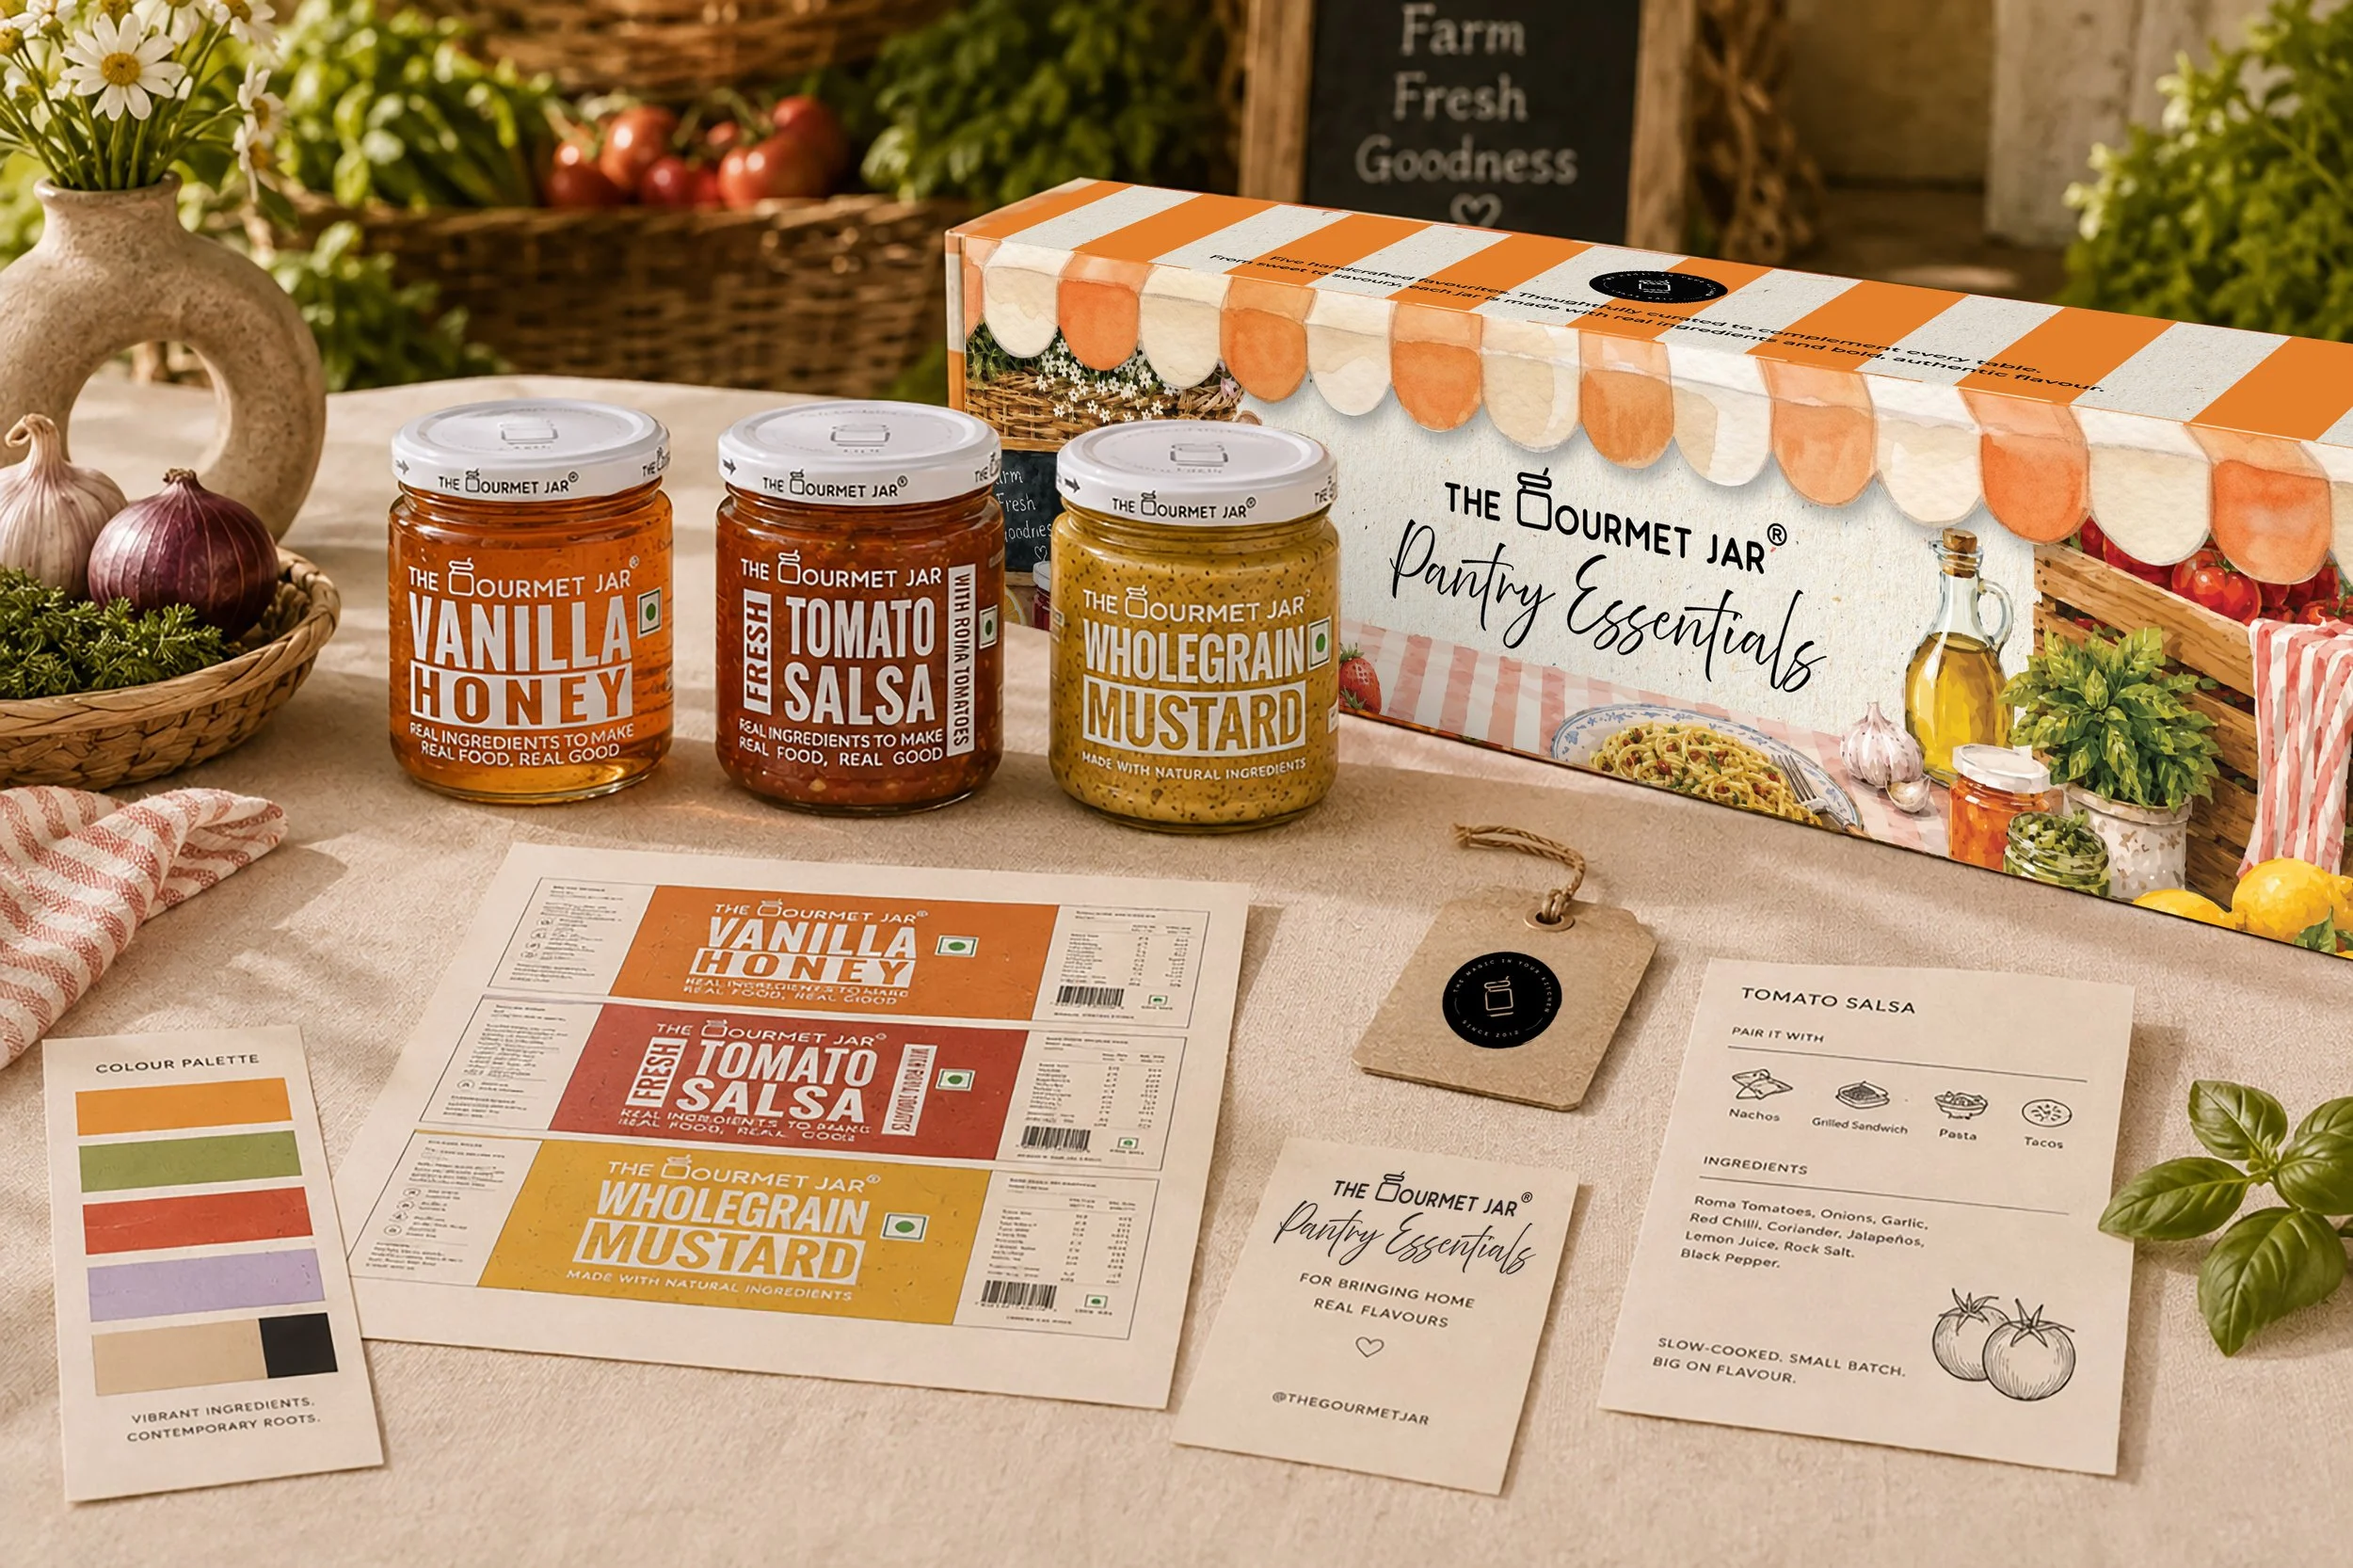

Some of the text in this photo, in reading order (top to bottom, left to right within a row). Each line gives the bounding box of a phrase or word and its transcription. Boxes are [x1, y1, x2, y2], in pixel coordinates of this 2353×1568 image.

[1401, 3, 1526, 56] Farm
[1393, 70, 1528, 121] Fresh
[1355, 133, 1578, 185] Goodness
[1209, 254, 1253, 264] From
[1257, 262, 1307, 273] sweet
[1409, 285, 1451, 295] each
[1449, 290, 1481, 298] jar
[1504, 298, 1560, 312] made
[1565, 307, 1609, 318] with
[1614, 314, 1653, 325] real
[1657, 320, 1778, 343] ingredients
[1783, 340, 1827, 350] and
[1893, 357, 2009, 377] authentic
[2015, 374, 2105, 392] flavour.
[1270, 255, 1305, 264] Five
[1307, 262, 1416, 280] handcrafted
[1519, 292, 1641, 314] Thoughtfully
[1647, 312, 1727, 327] curated
[1758, 328, 1901, 353] complement
[1906, 348, 1971, 363] every
[1977, 359, 2041, 374] table.
[438, 475, 460, 491] THE
[762, 476, 784, 493] THE
[996, 471, 1023, 485] arm
[996, 492, 1035, 512] Fresh
[1112, 497, 1136, 513] THE
[1444, 481, 1501, 522] THE
[1004, 520, 1051, 542] oodnes
[408, 566, 440, 592] THE
[741, 557, 770, 582] THE
[905, 567, 941, 587] JAR
[954, 573, 970, 613] WITH
[1082, 589, 1117, 614] THE
[1389, 518, 1828, 695] Pantry Essentials
[408, 591, 632, 672] VANILLA
[785, 595, 936, 659] TOMATO
[745, 599, 770, 709] FRESH
[1082, 618, 1305, 684] WHOLEGRAIN
[411, 664, 628, 728] HONEY
[783, 661, 936, 727] SALSA
[953, 665, 970, 746] TOMATOES
[1087, 682, 1303, 751] MUSTARD
[409, 722, 634, 750] REAL INGREDIENTS TO MAKE
[739, 717, 943, 748] REAL INGREDIENTS TO MAKE
[421, 741, 456, 760] REAL
[519, 752, 565, 766] REAL
[568, 744, 620, 763] GOOD
[739, 736, 943, 767] REAL FOOD, REAL GOOD
[1082, 750, 1306, 781] MADE WITH NATURAL INGREDIENTS
[714, 904, 749, 916] THE
[708, 916, 917, 959] VANILLA
[696, 951, 909, 985] HONEY
[1466, 960, 1495, 976] MAGIC
[1518, 961, 1540, 974] YOUR
[1541, 977, 1553, 1014] KITCHEN
[1741, 986, 1916, 1015] TOMATO SALSA
[656, 1023, 693, 1036] THE
[1462, 1019, 1489, 1036] SINCE
[1732, 1026, 1825, 1044] PAIR IT WITH
[95, 1053, 260, 1074] COLOUR PALETTE
[632, 1042, 679, 1102] FRESH
[695, 1040, 877, 1087] TOMATO
[676, 1078, 865, 1123] SALSA
[1729, 1107, 1781, 1123] Nachos
[1812, 1116, 1908, 1135] Grilled Sandwich
[1939, 1128, 1977, 1142] Pasta
[2025, 1136, 2064, 1150] Tacos
[608, 1160, 654, 1177] THE
[1703, 1156, 1808, 1176] INGREDIENTS
[1333, 1179, 1369, 1199] THE
[597, 1180, 870, 1235] WHOLEGRAIN
[1689, 1212, 1719, 1225] Red
[1694, 1194, 1737, 1210] Roma
[1740, 1200, 1816, 1220] Tomatoes,
[1820, 1208, 1877, 1225] Onions,
[581, 1223, 857, 1281] MUSTARD
[1273, 1200, 1536, 1275] Pantry Essentials
[1685, 1231, 1734, 1245] Lemon
[1784, 1240, 1820, 1255] Rock
[1680, 1248, 1781, 1270] Black Pepper.
[566, 1270, 853, 1302] MADE WITH NATURAL INGREDIENTS
[1300, 1272, 1475, 1309] FOR BRINGING HOME
[1314, 1298, 1449, 1329] REAL FLAVOURS
[1652, 1356, 1797, 1384] BIG ON FLAVOUR.
[1789, 1352, 1843, 1370] SMALL
[1848, 1360, 1907, 1378] BATCH.
[131, 1397, 315, 1424] VIBRANT INGREDIENTS.
[1272, 1391, 1430, 1426] @THEGOURMETJAR
[126, 1414, 321, 1442] CONTEMPORARY ROOTS.
